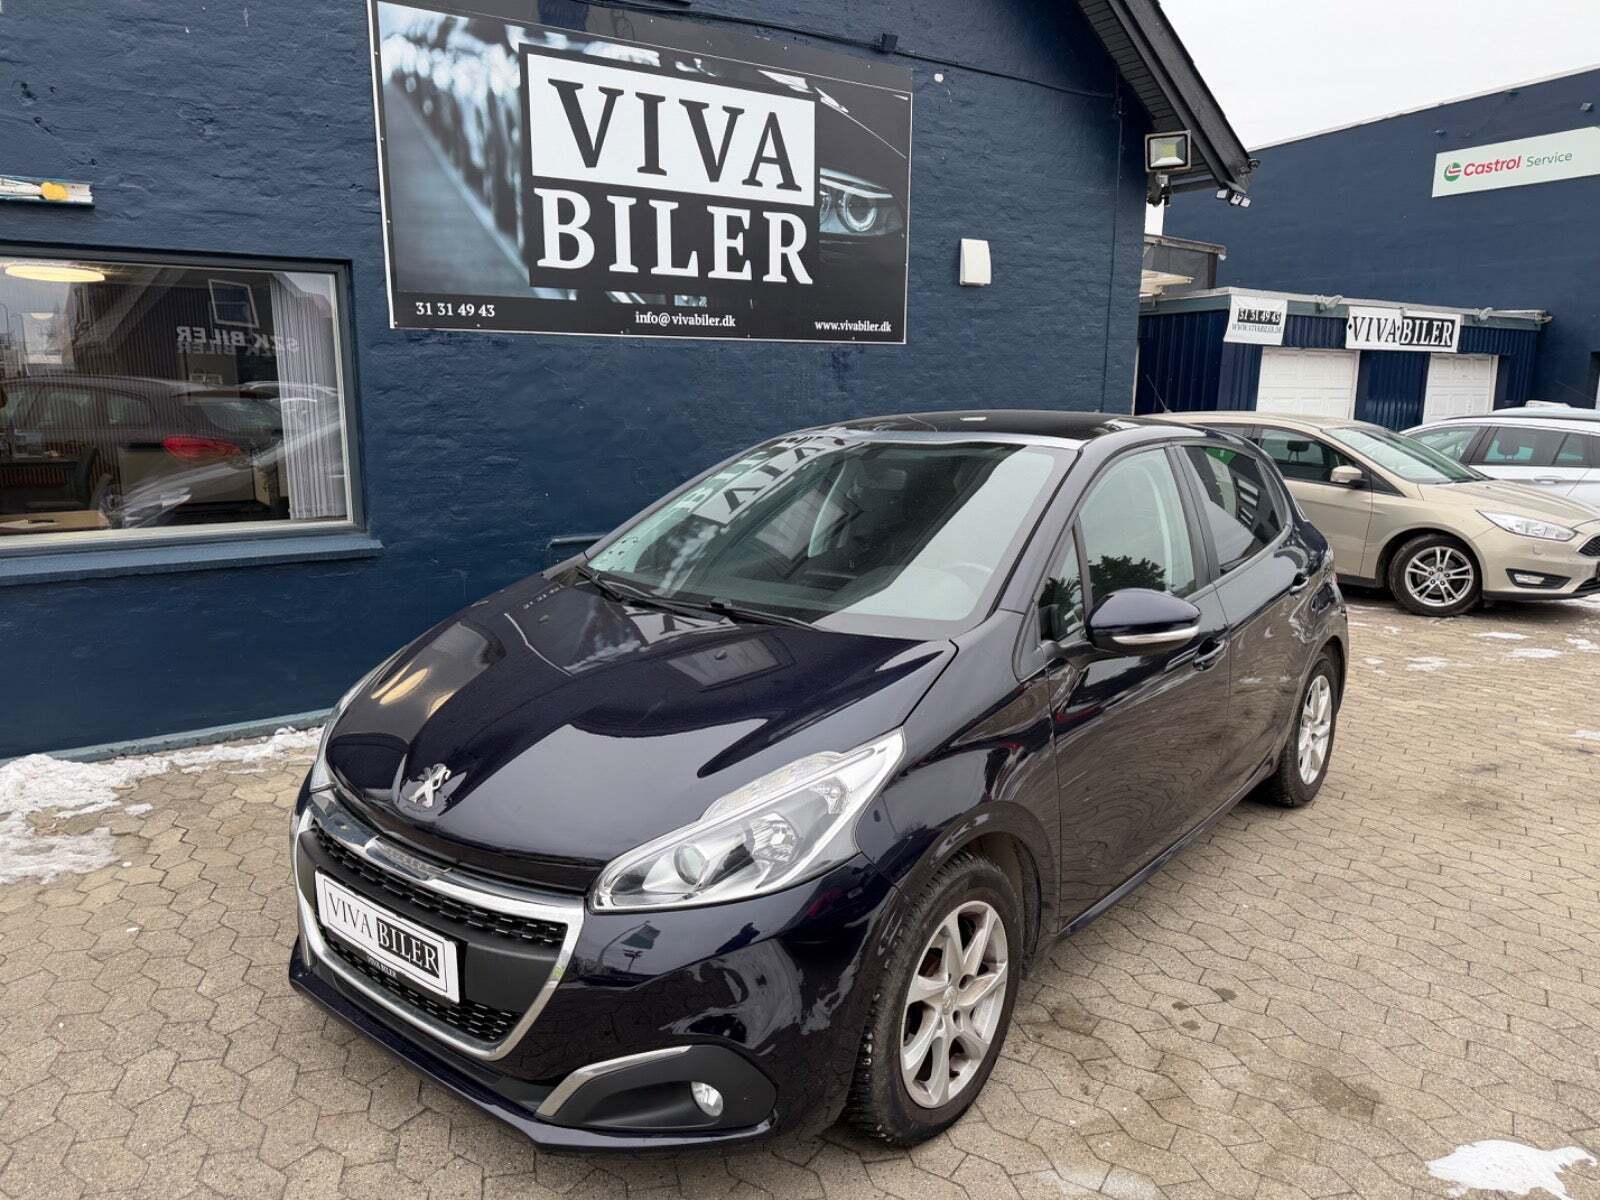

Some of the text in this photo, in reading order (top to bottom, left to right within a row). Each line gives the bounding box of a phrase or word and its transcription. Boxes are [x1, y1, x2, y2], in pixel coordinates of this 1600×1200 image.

[547, 77, 802, 193] VIVA
[1463, 150, 1573, 176] Castrol Service
[533, 186, 813, 285] BILER
[415, 302, 496, 318] 31 31 49 43
[635, 310, 736, 327] info@vivabiler.dk
[814, 319, 892, 333] www.vivabiler.dk
[1352, 315, 1454, 347] VIVA BILER
[328, 892, 440, 977] VIVA BILER
